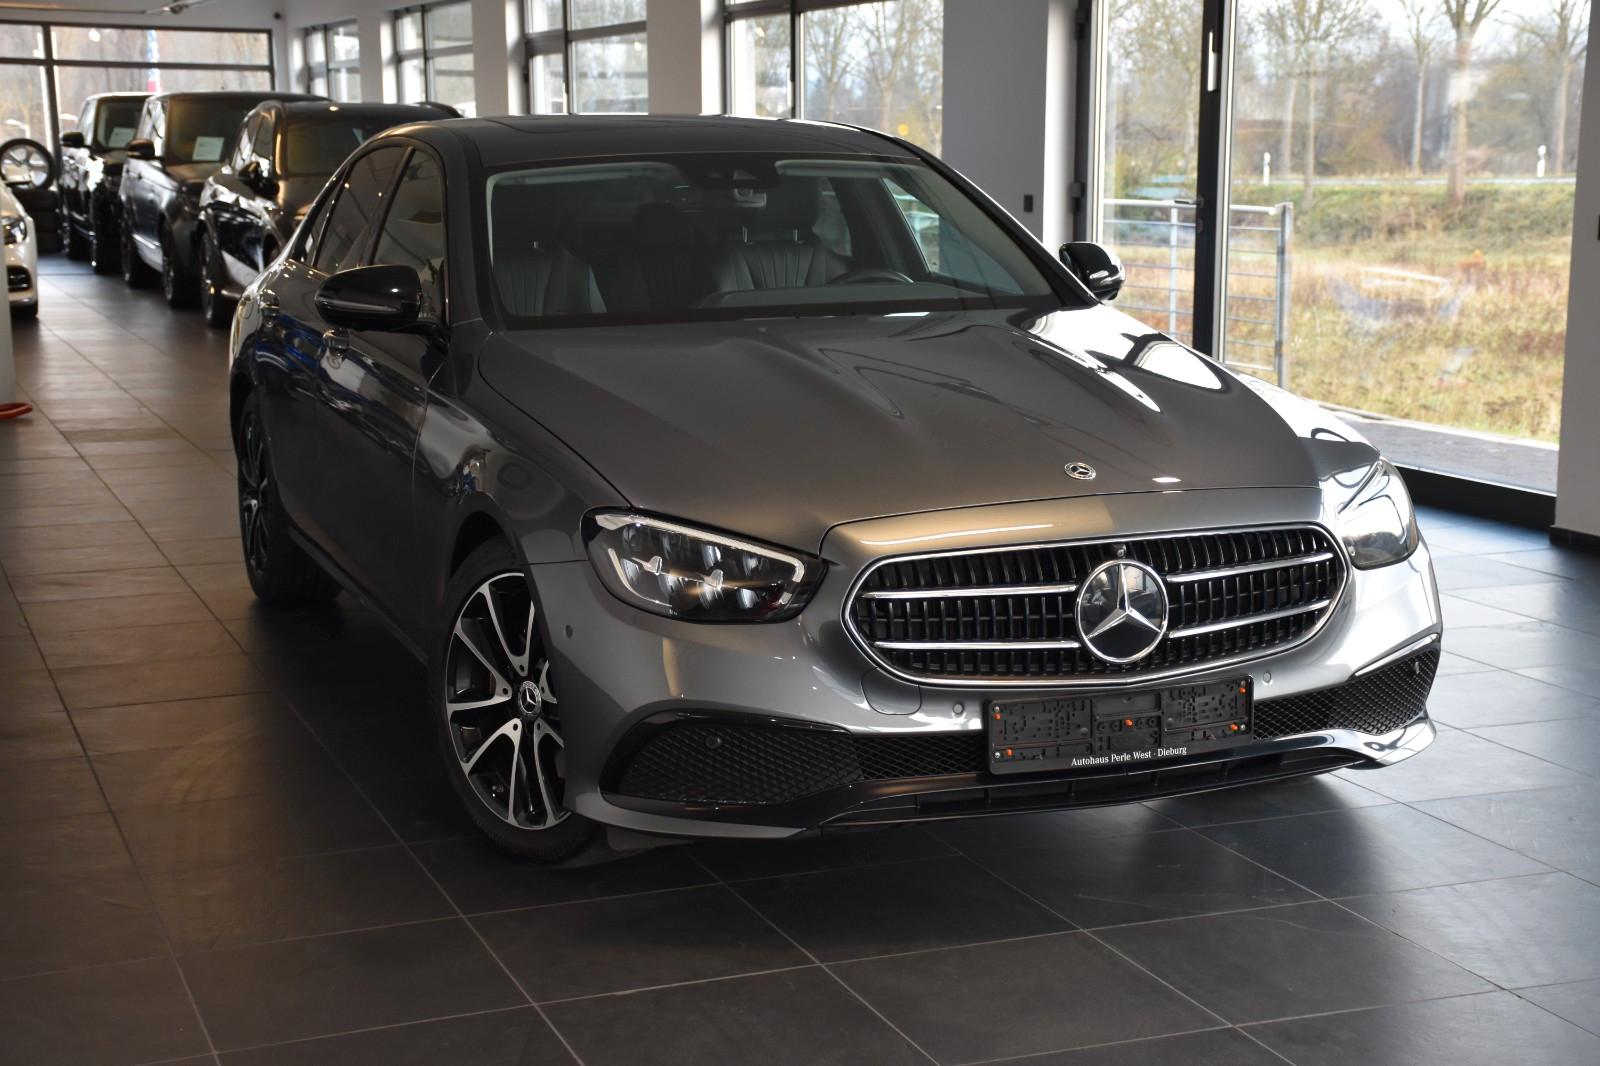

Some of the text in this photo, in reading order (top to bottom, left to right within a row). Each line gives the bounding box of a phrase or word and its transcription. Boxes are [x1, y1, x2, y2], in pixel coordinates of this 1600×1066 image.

[1071, 756, 1109, 766] Autohaus
[1111, 753, 1131, 763] Perle
[1133, 750, 1152, 760] West
[1157, 746, 1187, 757] Dieburg
